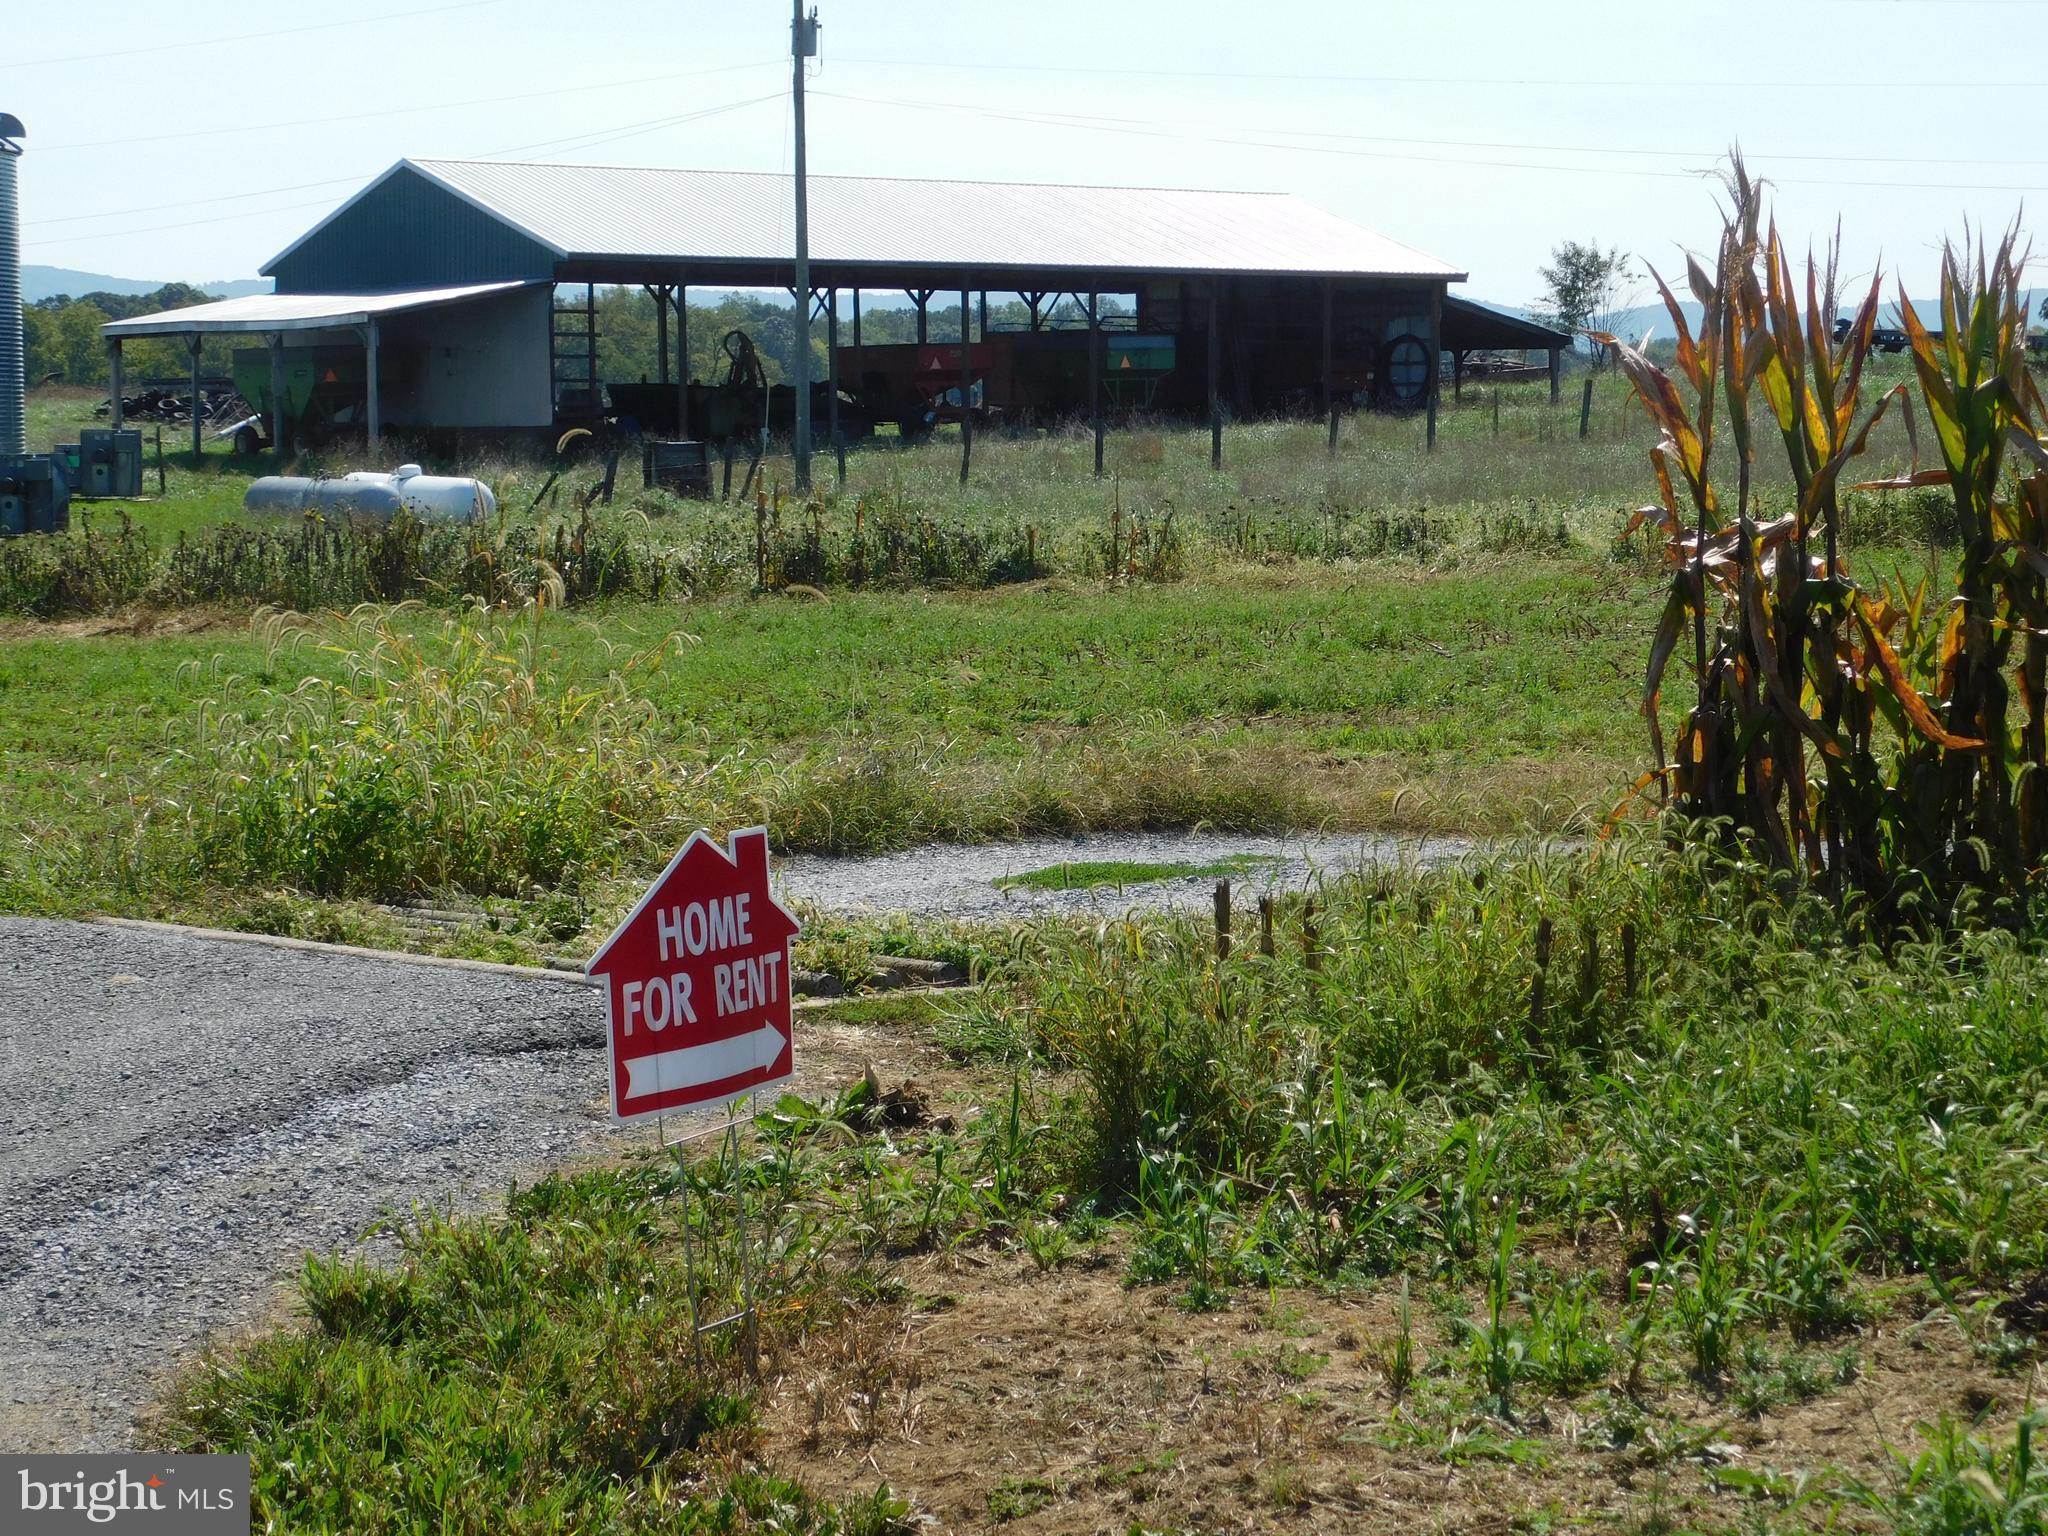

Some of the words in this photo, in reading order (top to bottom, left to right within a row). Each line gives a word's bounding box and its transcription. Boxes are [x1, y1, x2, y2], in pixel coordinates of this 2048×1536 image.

[656, 892, 752, 961] HOME
[622, 972, 698, 1036] FOR
[714, 951, 782, 1017] RENT
